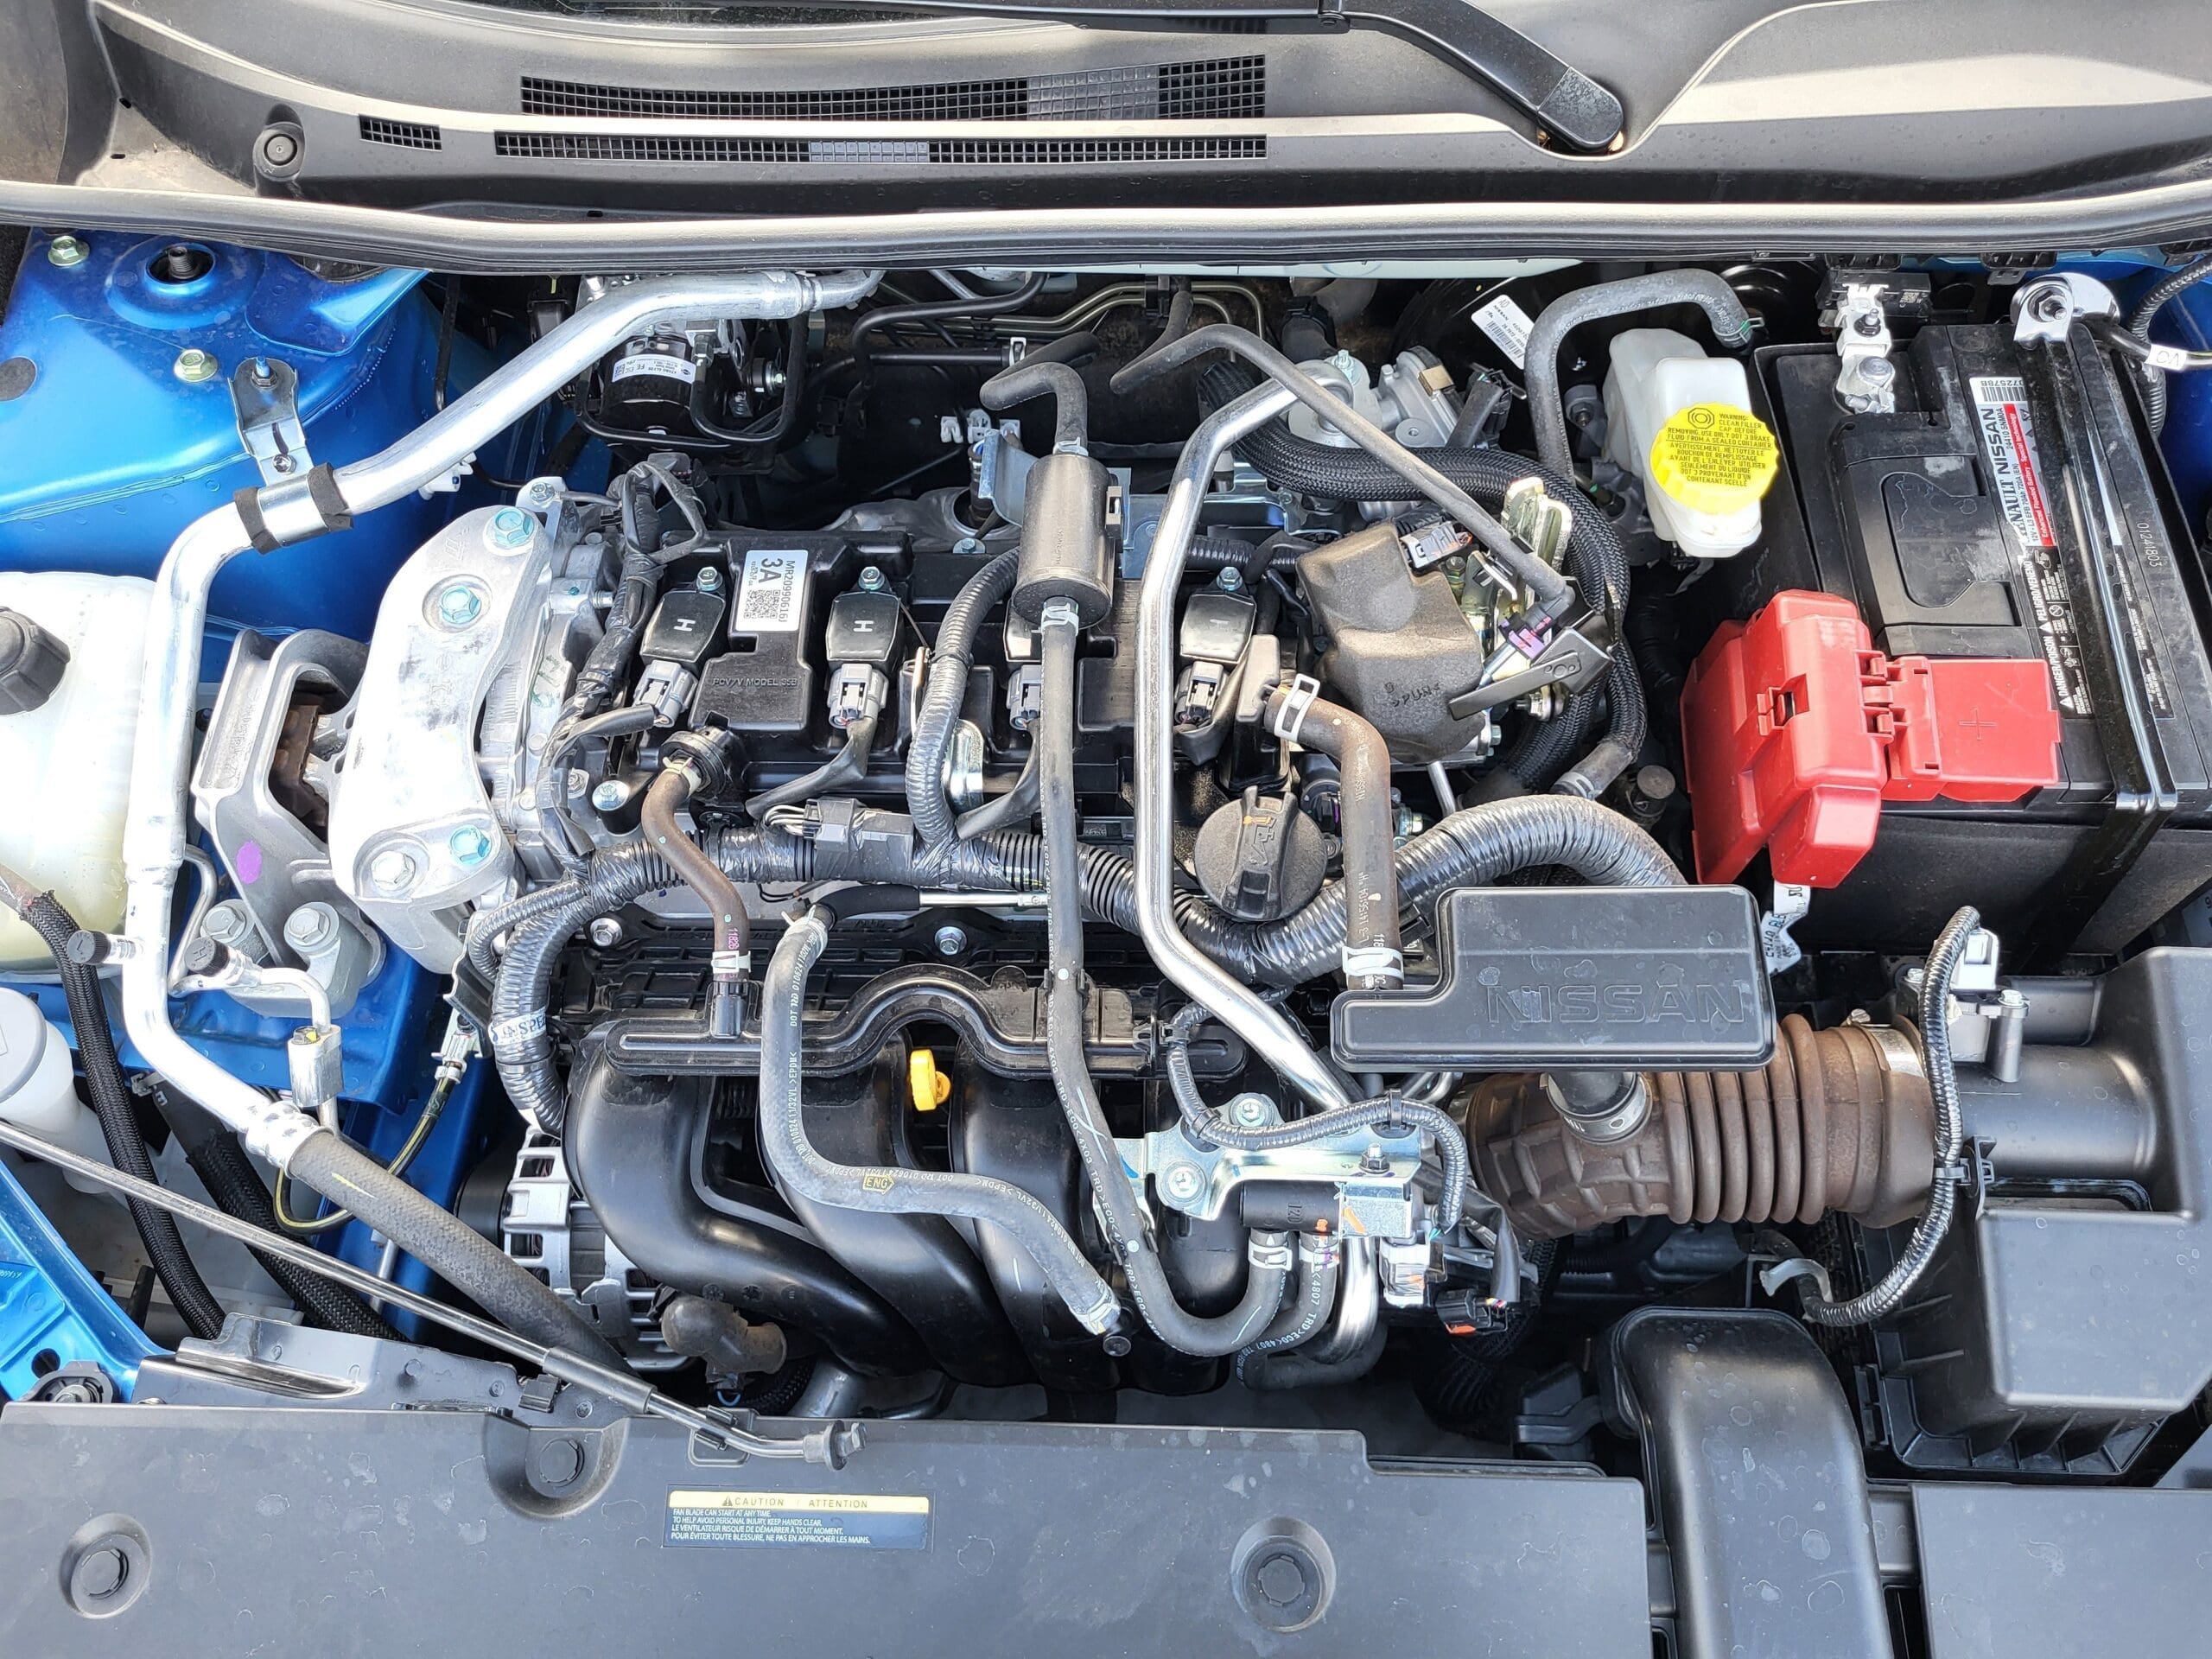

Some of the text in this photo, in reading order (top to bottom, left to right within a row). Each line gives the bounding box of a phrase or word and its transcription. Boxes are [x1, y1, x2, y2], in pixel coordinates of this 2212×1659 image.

[1712, 436, 1737, 445] SEALED
[1980, 408, 2011, 475] NISSAN
[1676, 448, 1704, 457] BOUCHON
[1714, 452, 1758, 461] REMPLISSAGE
[1724, 446, 1755, 455] NETTOYER
[1681, 462, 1717, 471] SEULEMENT
[1738, 461, 1766, 469] UTILISER
[1687, 475, 1723, 484] CONTENANT
[1699, 470, 1736, 480] PROVENANT
[759, 558, 783, 583] 3A
[779, 560, 795, 622] MR20990616J
[2043, 636, 2069, 696] DANGER/POISON
[746, 677, 779, 686] MODEL
[1486, 984, 1745, 1023] NISSAN
[866, 1177, 889, 1188] ENG
[734, 1497, 868, 1509] CAUTION ATTENTION
[755, 1524, 790, 1534] DÉMARRER
[790, 1525, 795, 1534] À
[690, 1531, 711, 1540] ÉVITER
[733, 1533, 765, 1541] BLESSURE,
[798, 1535, 837, 1543] APPROCHER
